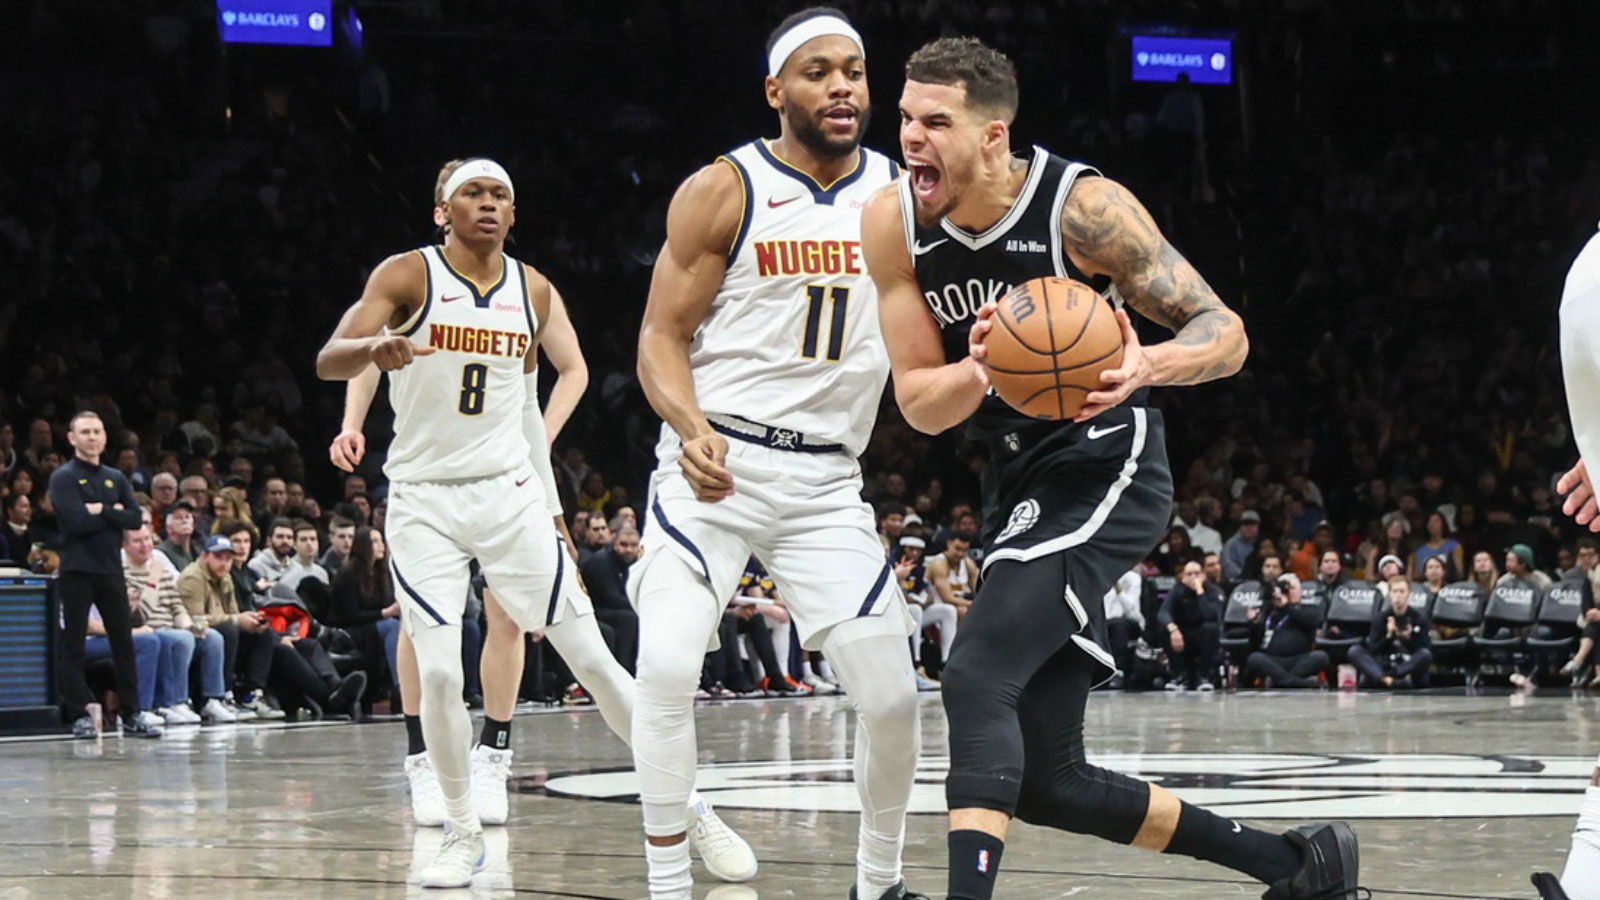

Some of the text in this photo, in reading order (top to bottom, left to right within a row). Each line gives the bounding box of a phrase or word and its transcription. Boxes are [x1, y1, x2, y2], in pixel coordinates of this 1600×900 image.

[238, 12, 299, 27] BARCLAYS
[1151, 53, 1203, 68] BARCLAYS
[1006, 240, 1046, 253] All In Won
[754, 239, 872, 278] NUGGE
[495, 302, 522, 313] ibotta
[924, 278, 1013, 330] ROOK
[802, 284, 850, 362] 11
[429, 323, 529, 359] NUGGETS
[458, 362, 489, 416] 8
[1339, 588, 1376, 601] QATAR
[1496, 587, 1533, 600] QATAR
[1550, 588, 1582, 600] QATA
